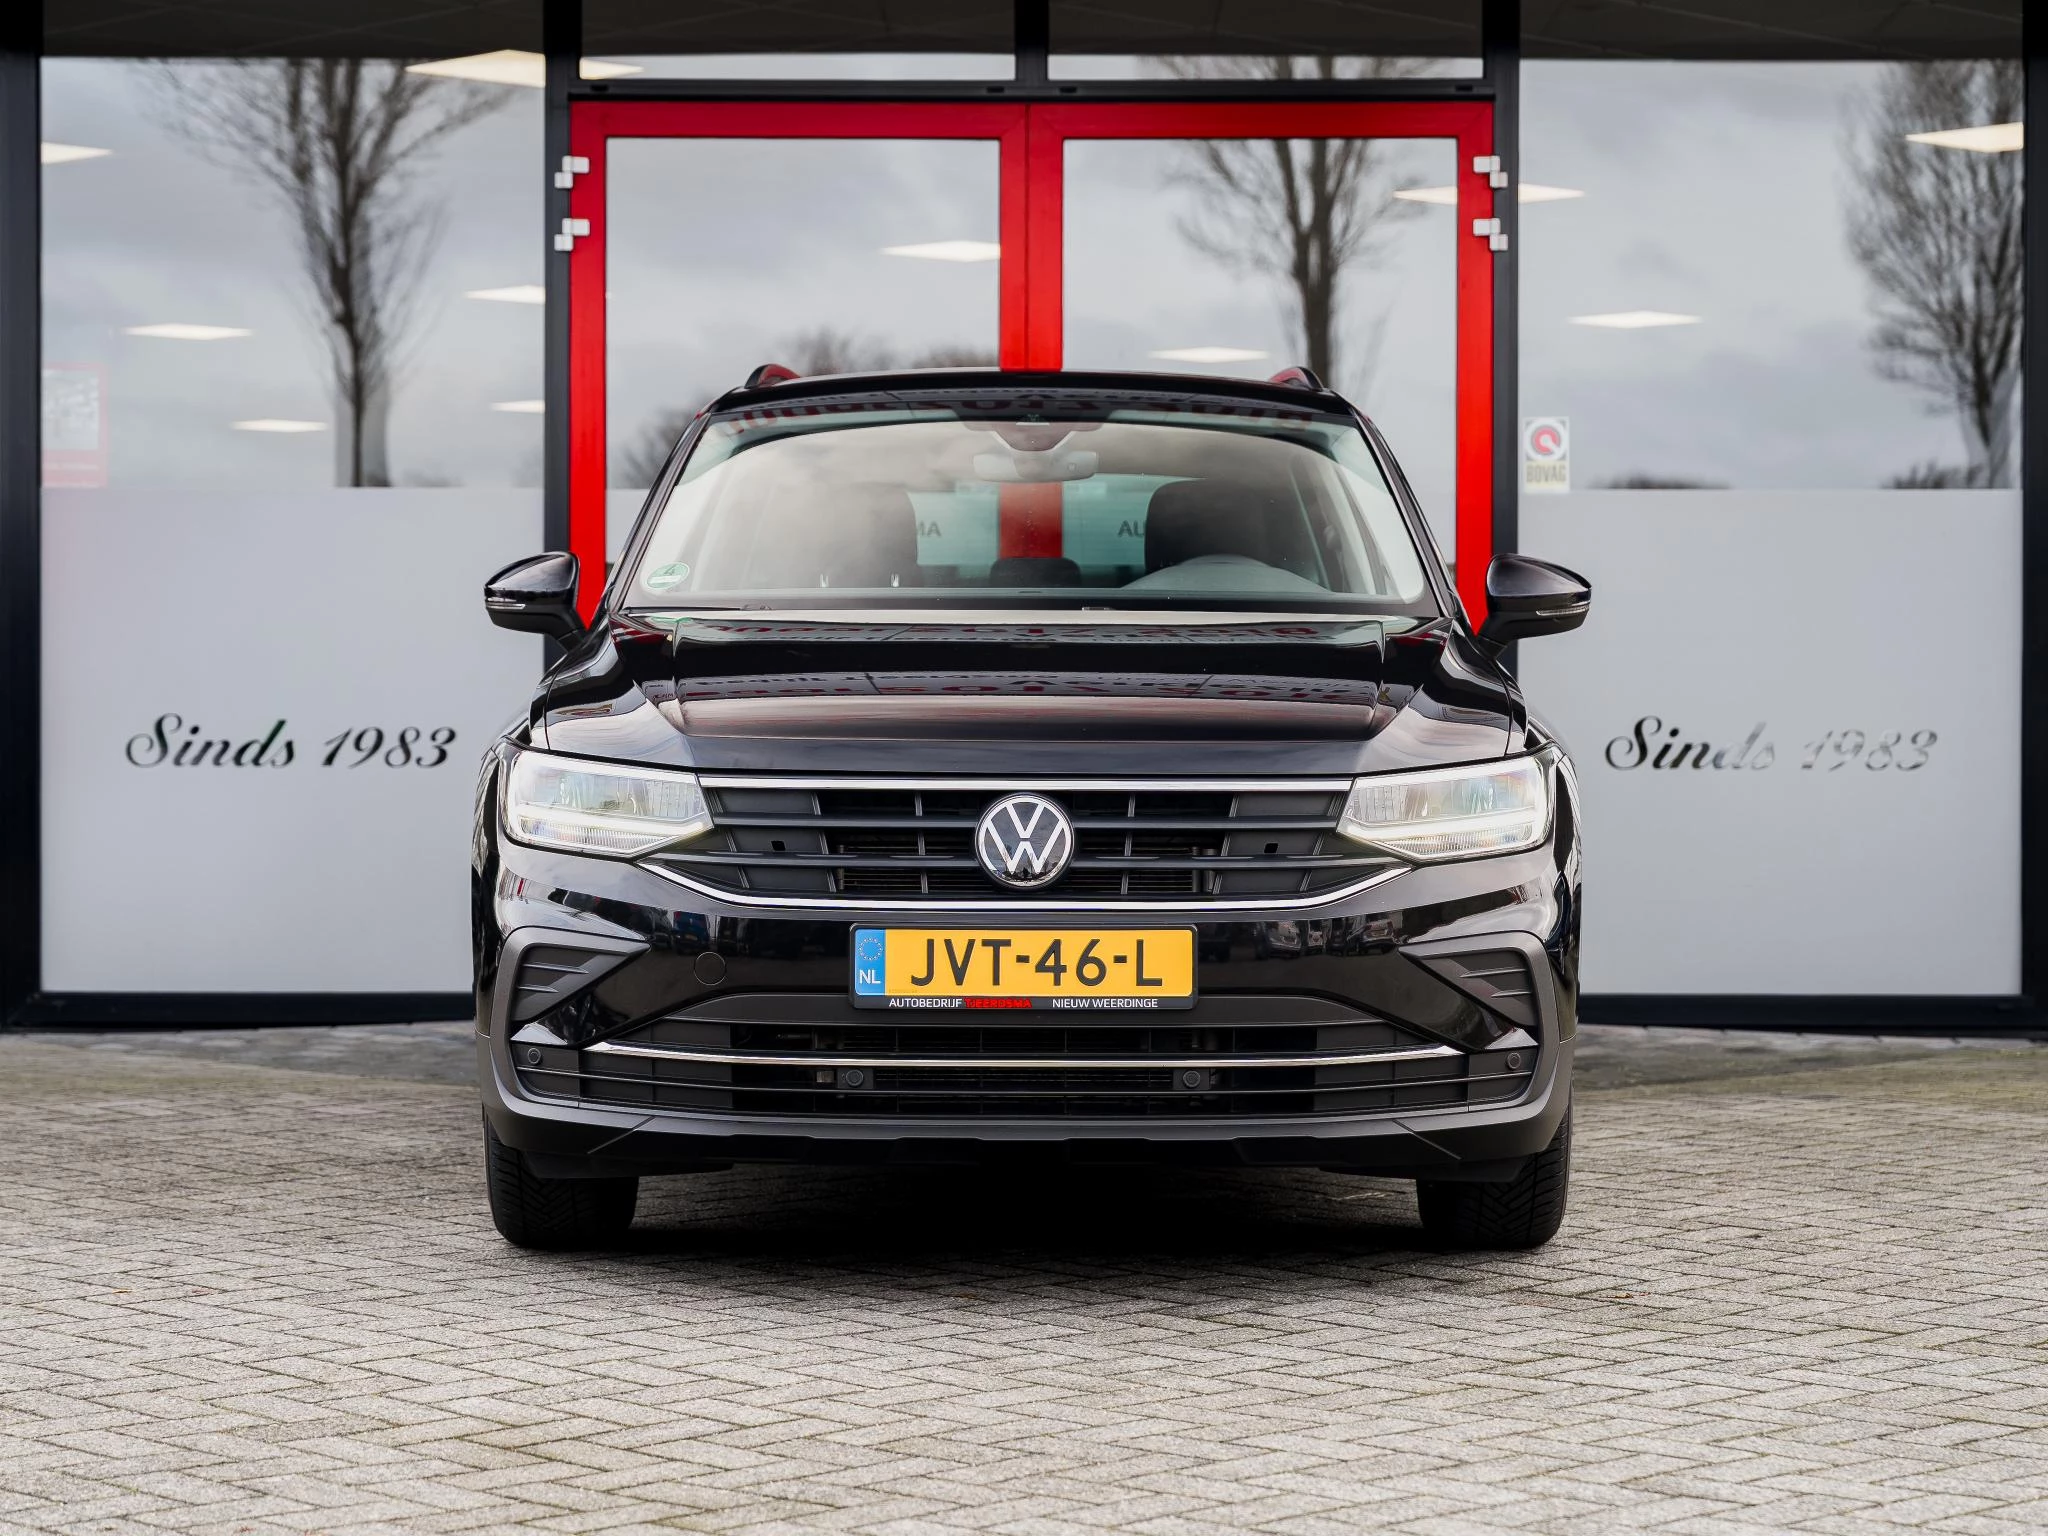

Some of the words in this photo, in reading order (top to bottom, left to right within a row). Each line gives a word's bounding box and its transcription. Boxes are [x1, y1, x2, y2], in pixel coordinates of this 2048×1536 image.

[125, 712, 295, 769] Sinds
[320, 726, 457, 769] 1983
[1604, 715, 1776, 772] Sinds
[1800, 728, 1938, 772] 1983
[859, 969, 881, 985] NL
[910, 938, 1163, 987] JVT-46-L
[888, 997, 963, 1009] AUTOBEDRIJF
[1052, 998, 1091, 1008] NIEUW
[1091, 998, 1159, 1008] WEERDINGE
